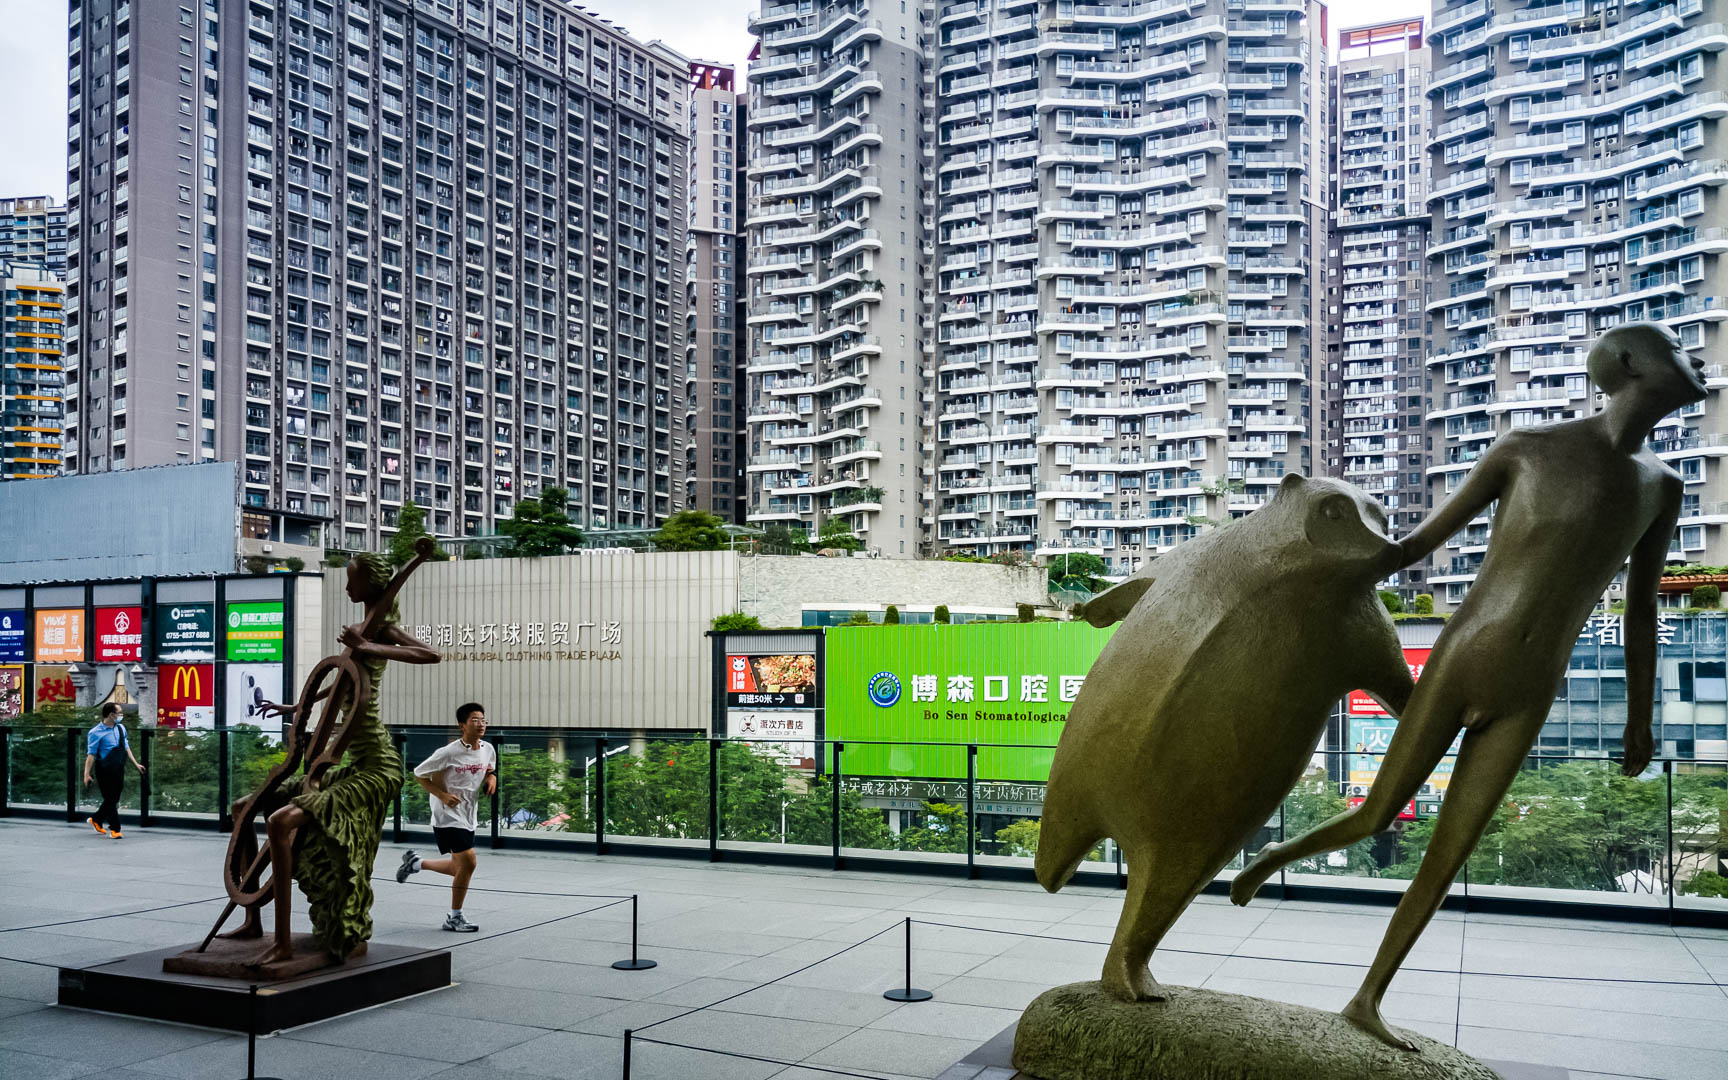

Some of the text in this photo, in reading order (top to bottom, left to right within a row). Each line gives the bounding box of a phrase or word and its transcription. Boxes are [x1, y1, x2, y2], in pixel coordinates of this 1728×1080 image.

[470, 651, 503, 662] GLOBAL
[506, 651, 551, 661] CLOTHING
[555, 650, 587, 661] TRADE
[590, 650, 622, 661] PLAZA
[924, 710, 1069, 724] Bo Sen Stomatologica
